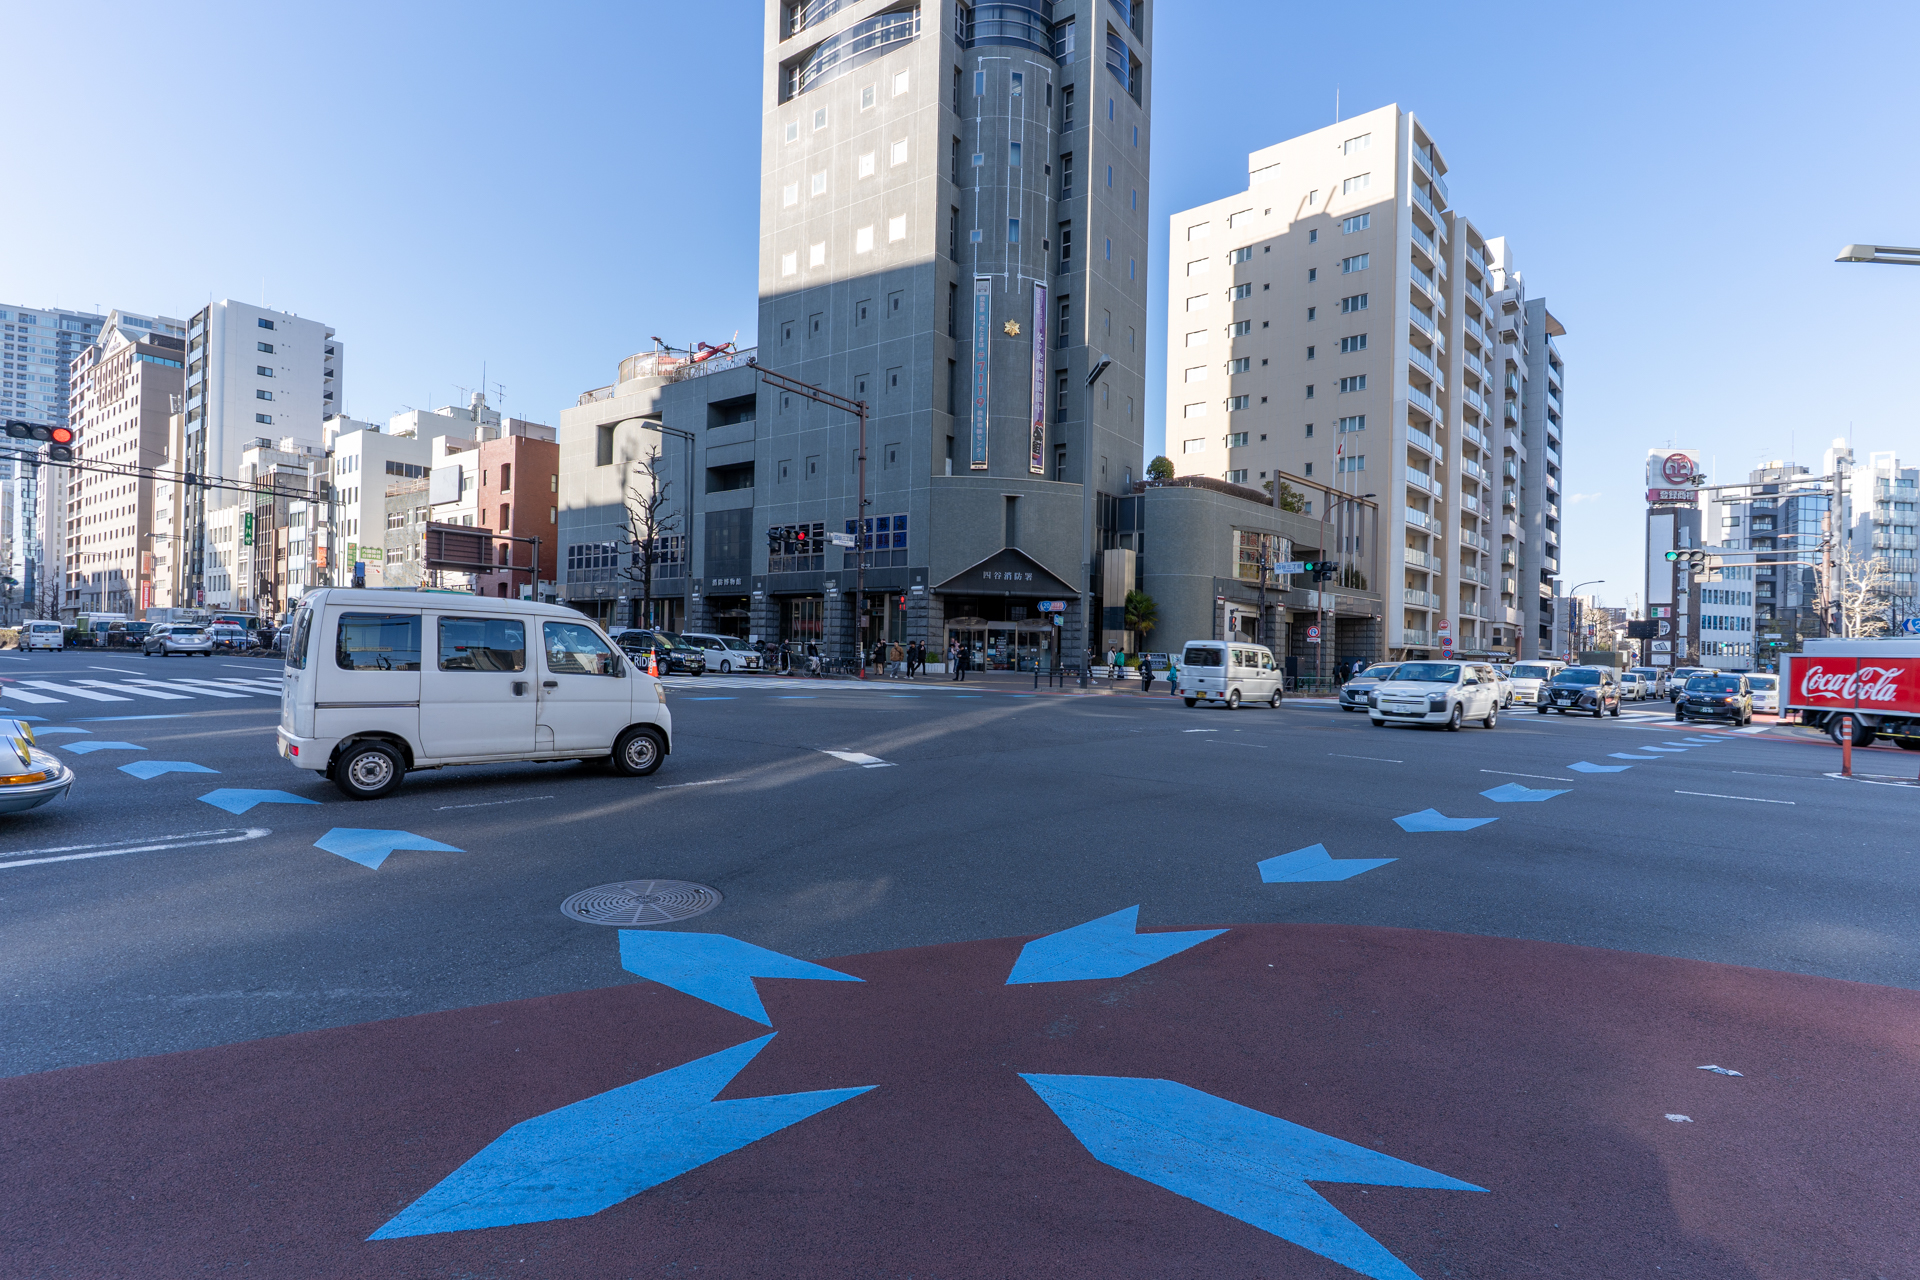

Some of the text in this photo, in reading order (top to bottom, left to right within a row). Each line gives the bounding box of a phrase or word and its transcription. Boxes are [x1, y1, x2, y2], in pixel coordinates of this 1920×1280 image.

[983, 571, 1033, 581] 四谷消防署
[711, 578, 742, 587] 消防博物館
[1801, 665, 1906, 702] Coca-Cola
